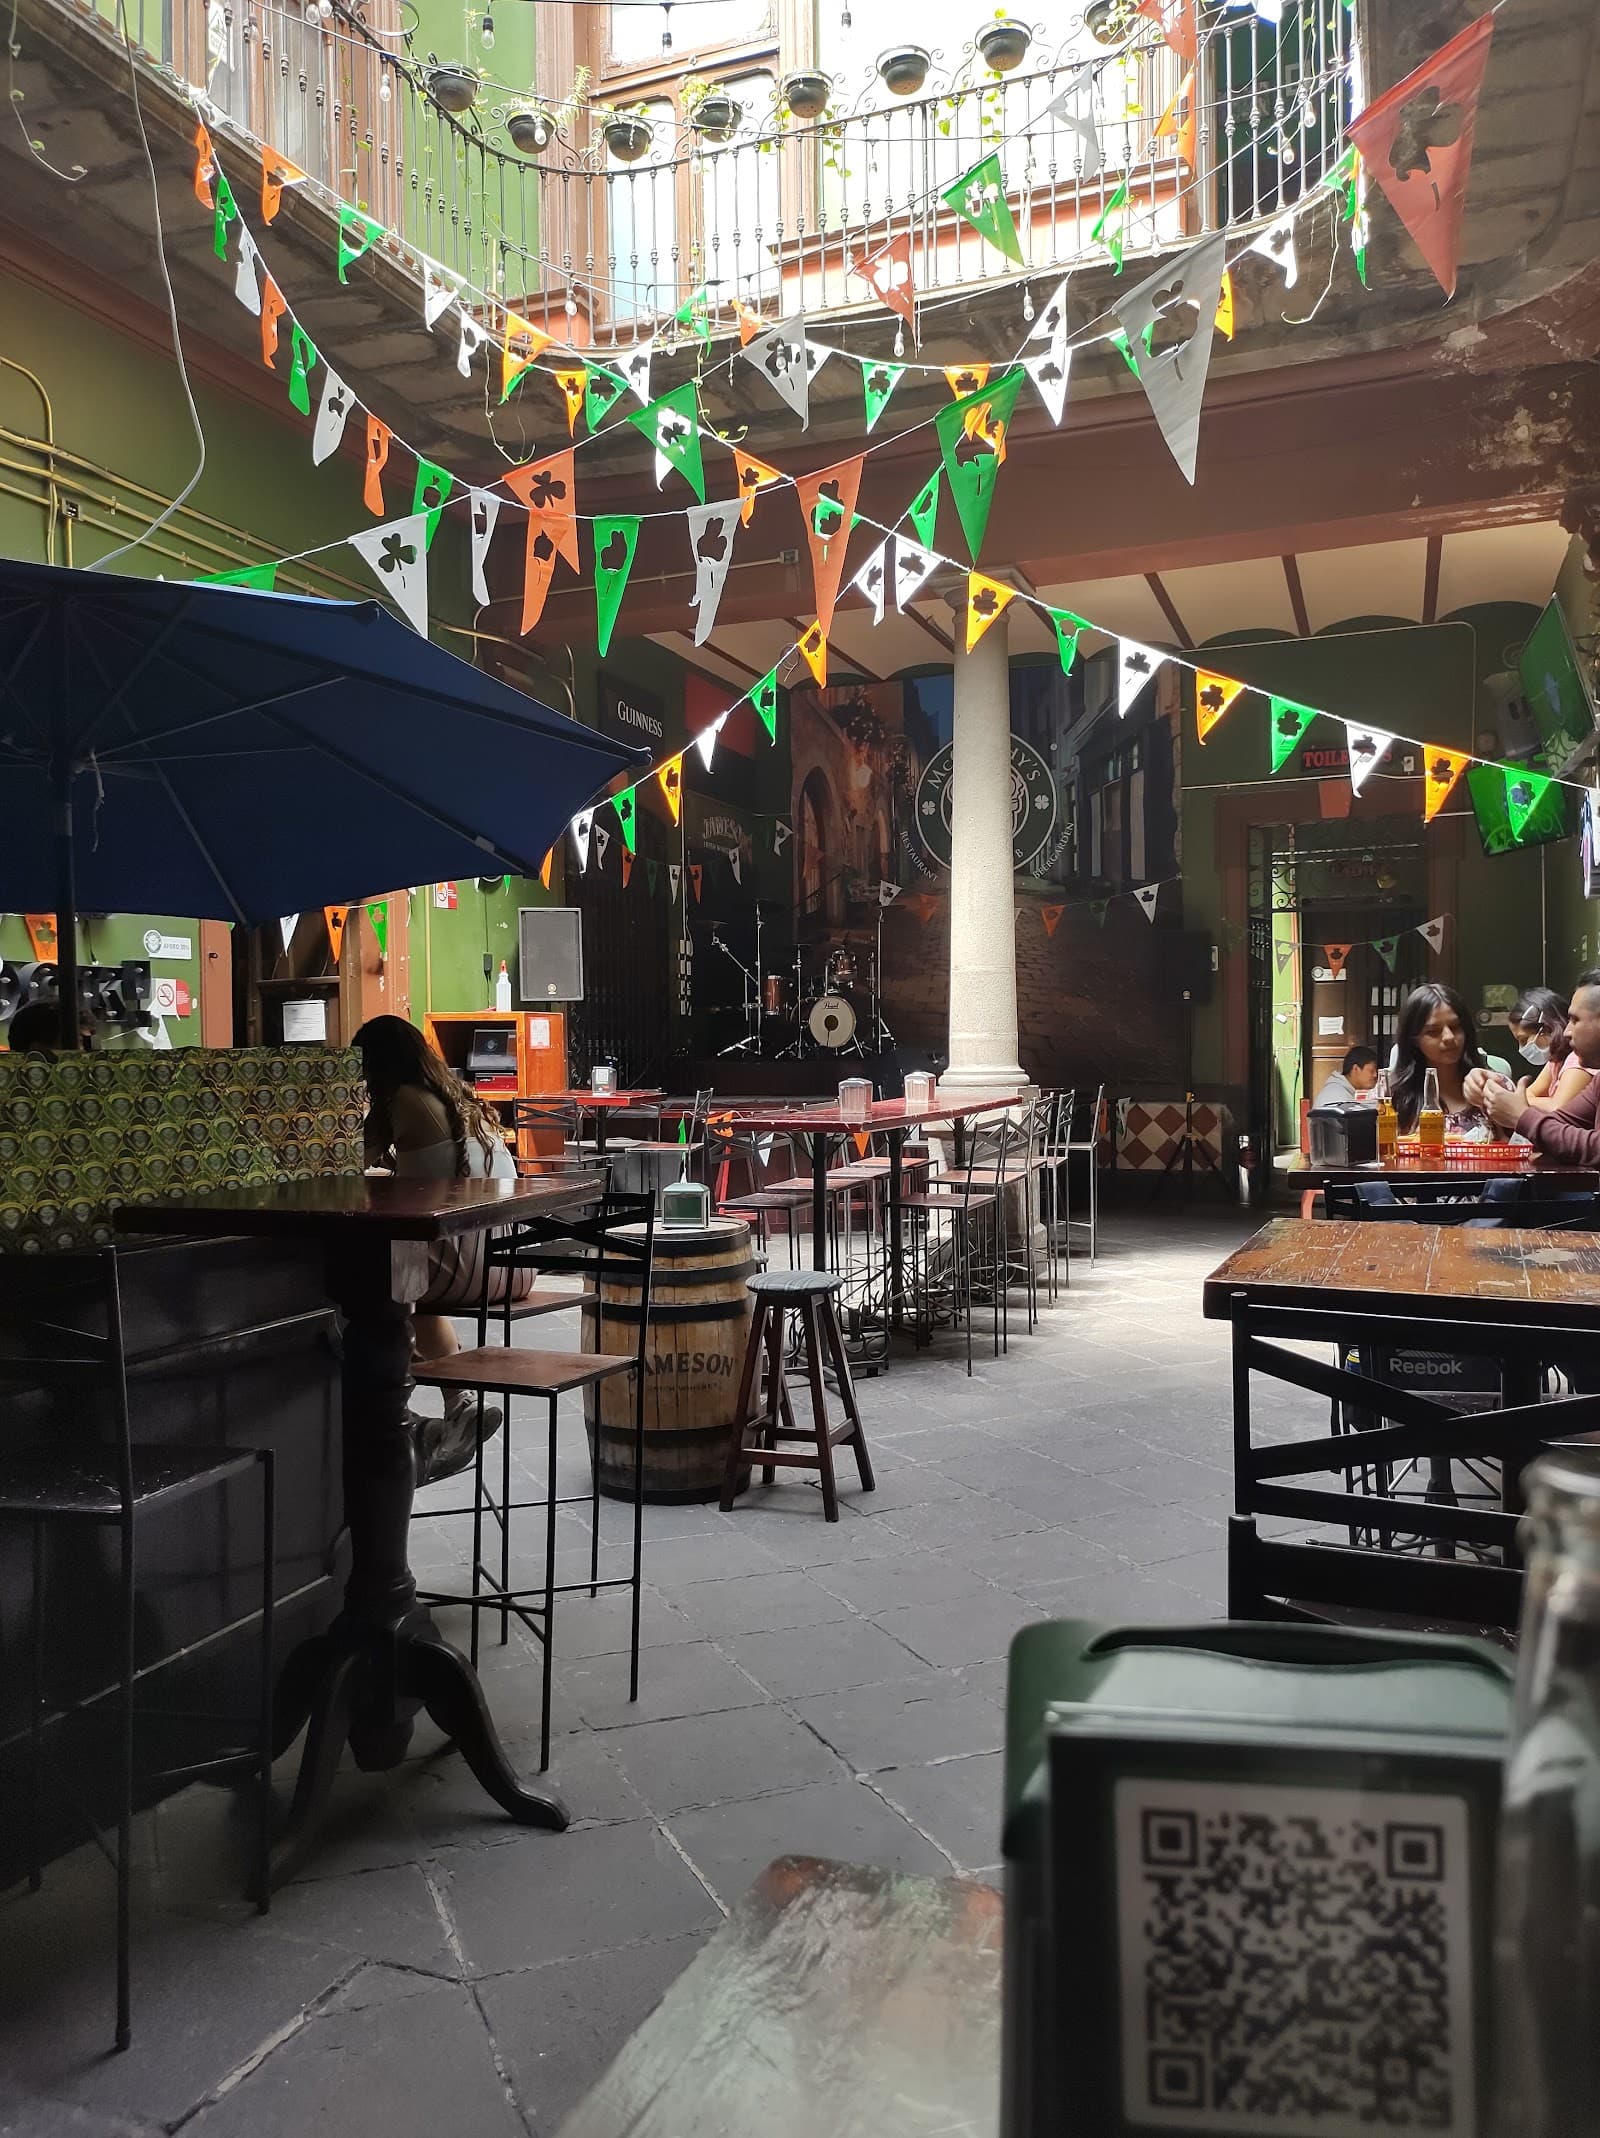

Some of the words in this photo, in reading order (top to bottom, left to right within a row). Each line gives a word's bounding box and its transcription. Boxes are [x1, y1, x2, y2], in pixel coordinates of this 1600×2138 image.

[617, 700, 663, 738] GUINNESS
[900, 830, 938, 882] RESTAURANT
[1389, 1358, 1464, 1375] Reebok
